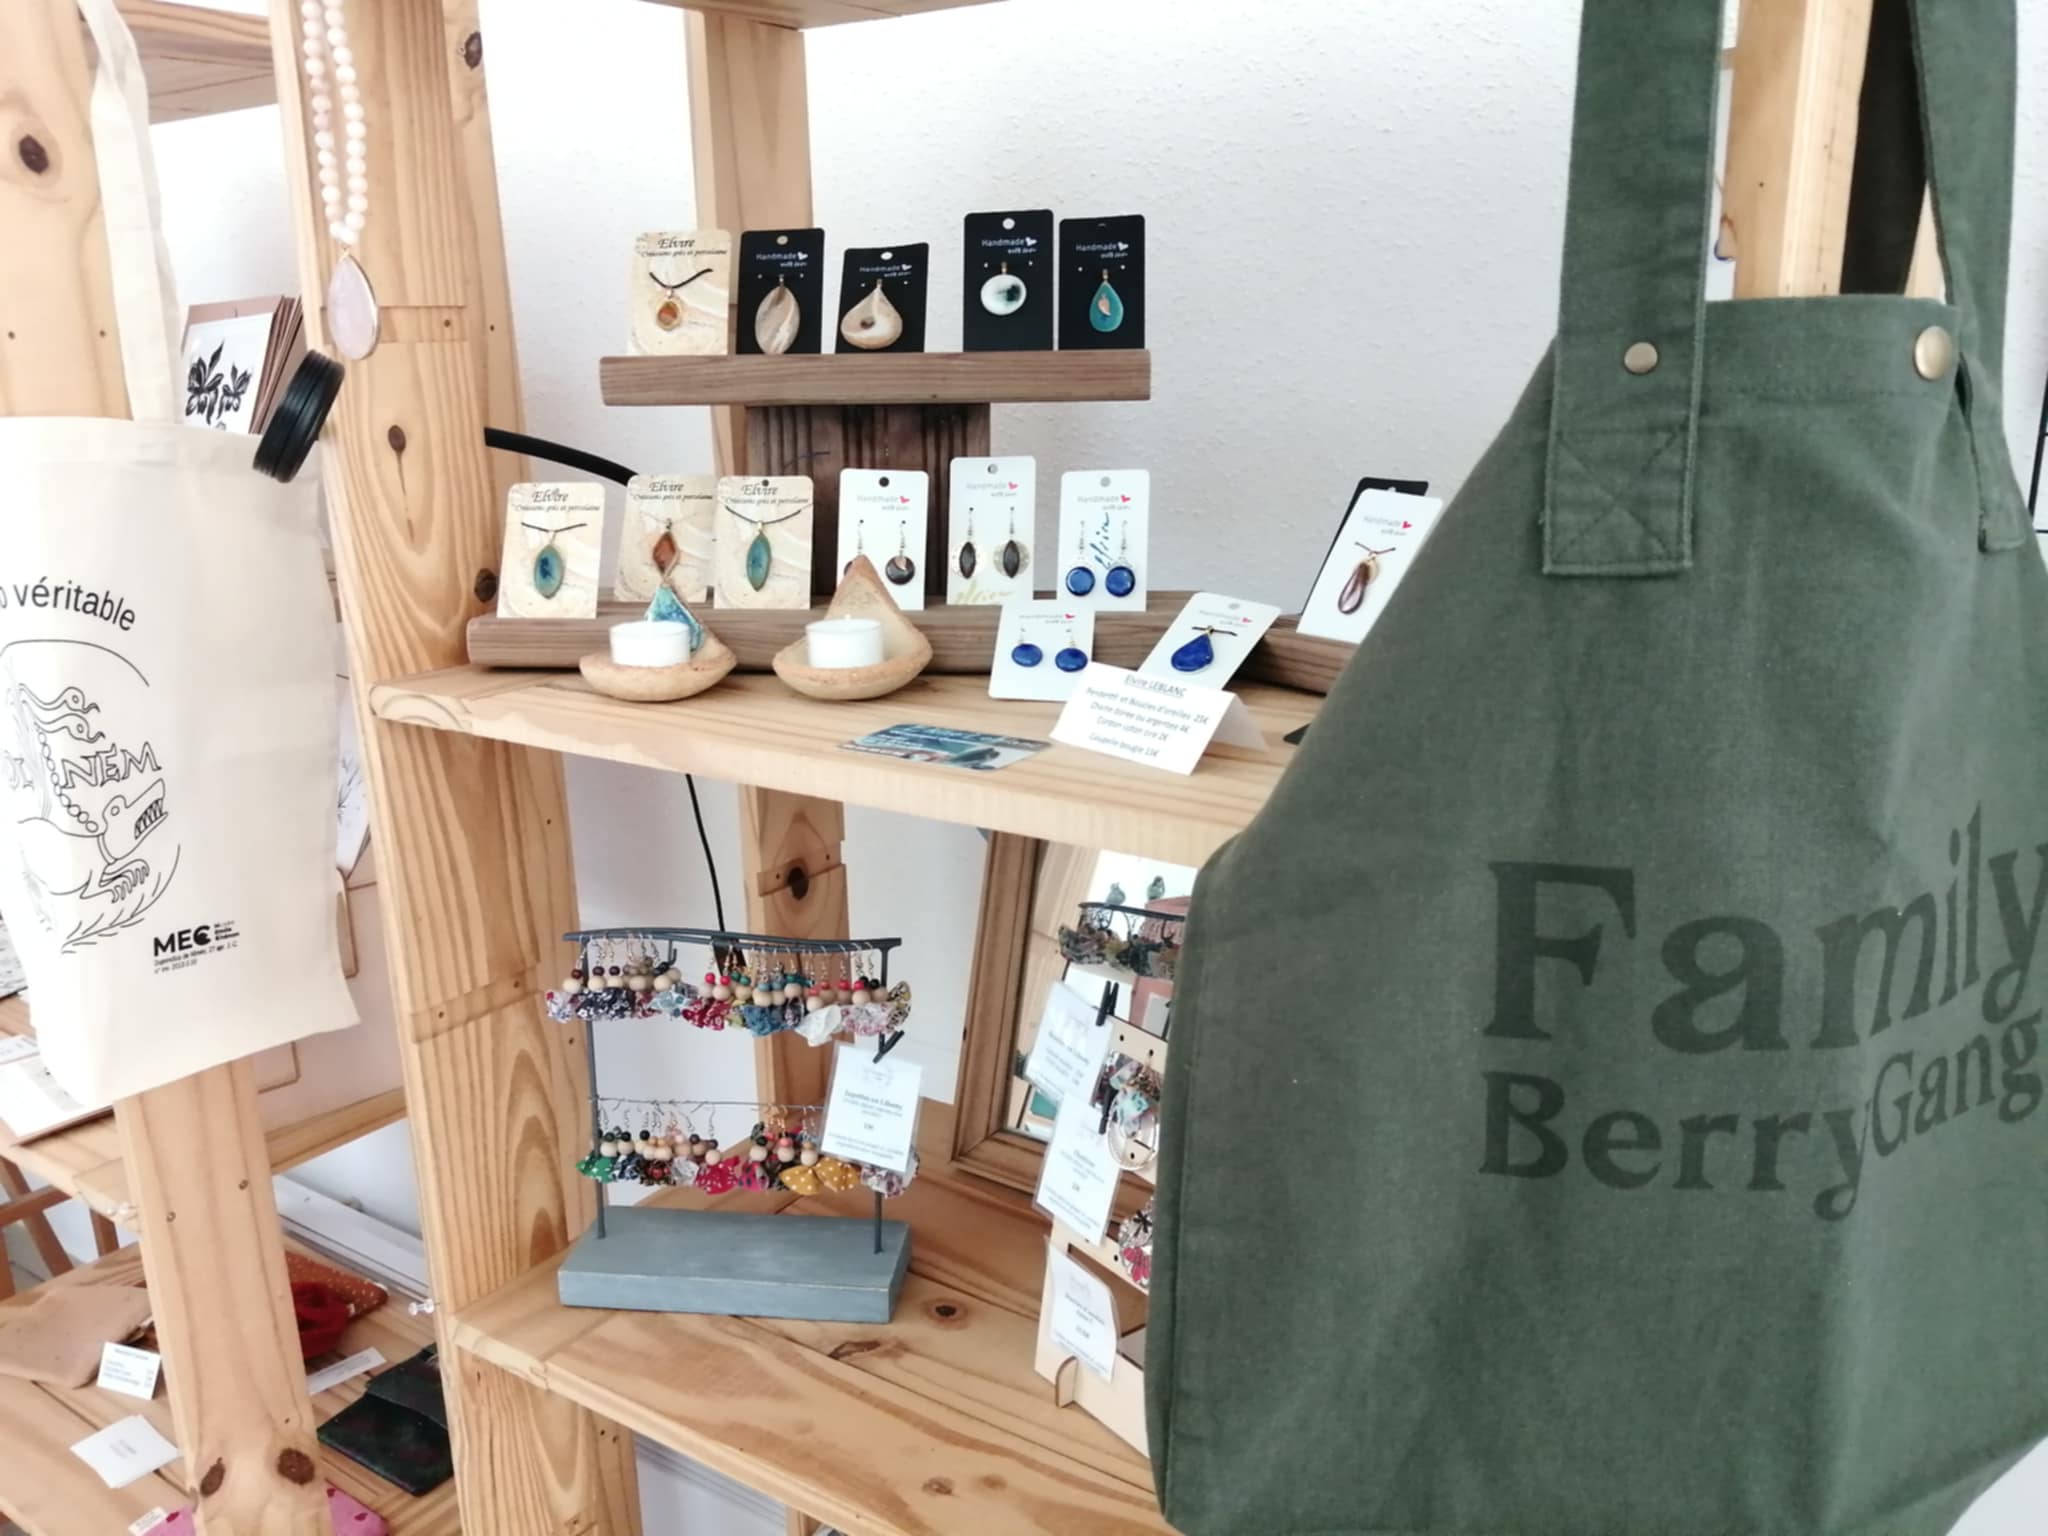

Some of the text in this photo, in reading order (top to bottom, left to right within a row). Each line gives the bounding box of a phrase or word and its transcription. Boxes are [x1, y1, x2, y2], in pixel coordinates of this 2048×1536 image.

[657, 236, 695, 249] Elvire
[981, 237, 1025, 247] Handmade
[649, 480, 685, 493] Elvire
[741, 482, 779, 496] Elvire
[13, 576, 136, 632] véritable
[1483, 800, 2048, 1055] Family
[153, 924, 211, 957] MEC
[1478, 1008, 2045, 1222] Berry Gang
